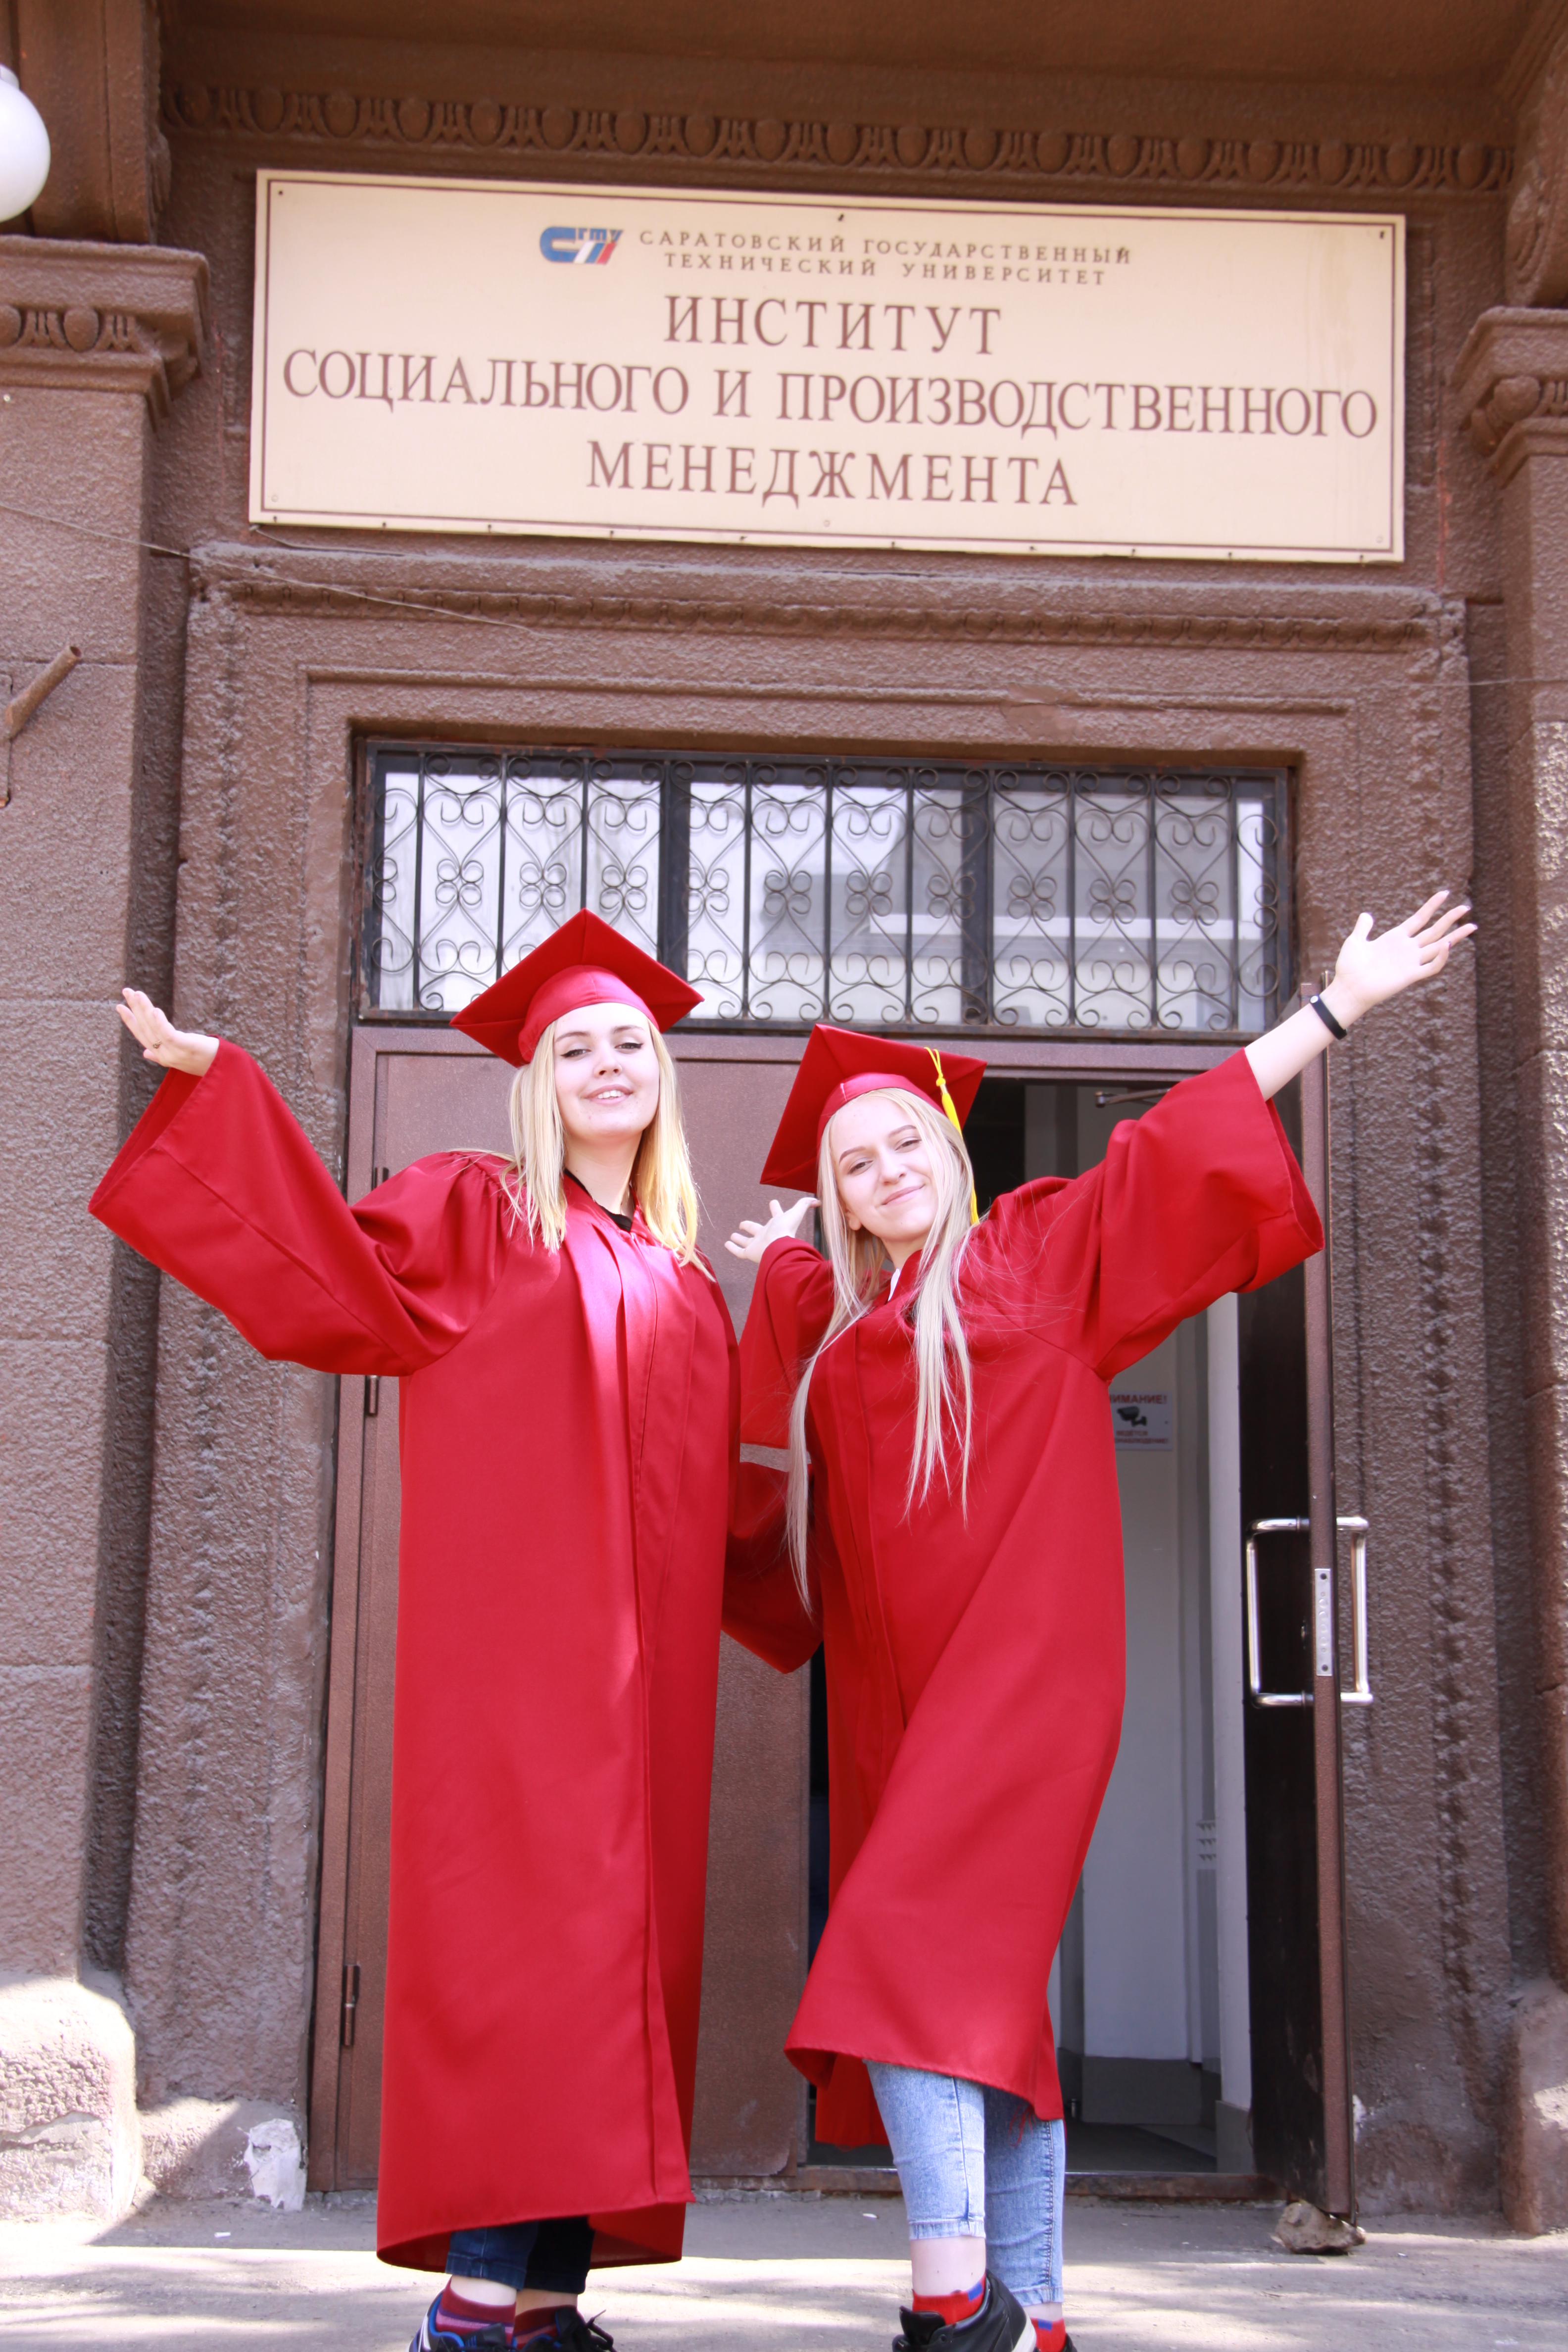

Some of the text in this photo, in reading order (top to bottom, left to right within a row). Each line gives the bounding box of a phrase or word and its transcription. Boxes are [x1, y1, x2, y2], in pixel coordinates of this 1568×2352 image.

[639, 231, 1130, 264] САРАТОВСКИЙ ГОСУДАРСТВЕННЫЙ
[664, 253, 1104, 286] ТЕХНИЧЕСКИЙ УНИВЕРСИТЕТ
[664, 295, 1001, 355] ИНСТИТУТ
[283, 349, 1377, 439] СОЦИАЛЬНОГО И ПРОИЗВОДСТВЕННОГО
[587, 440, 1078, 507] МЕНЕДЖМЕНТА
